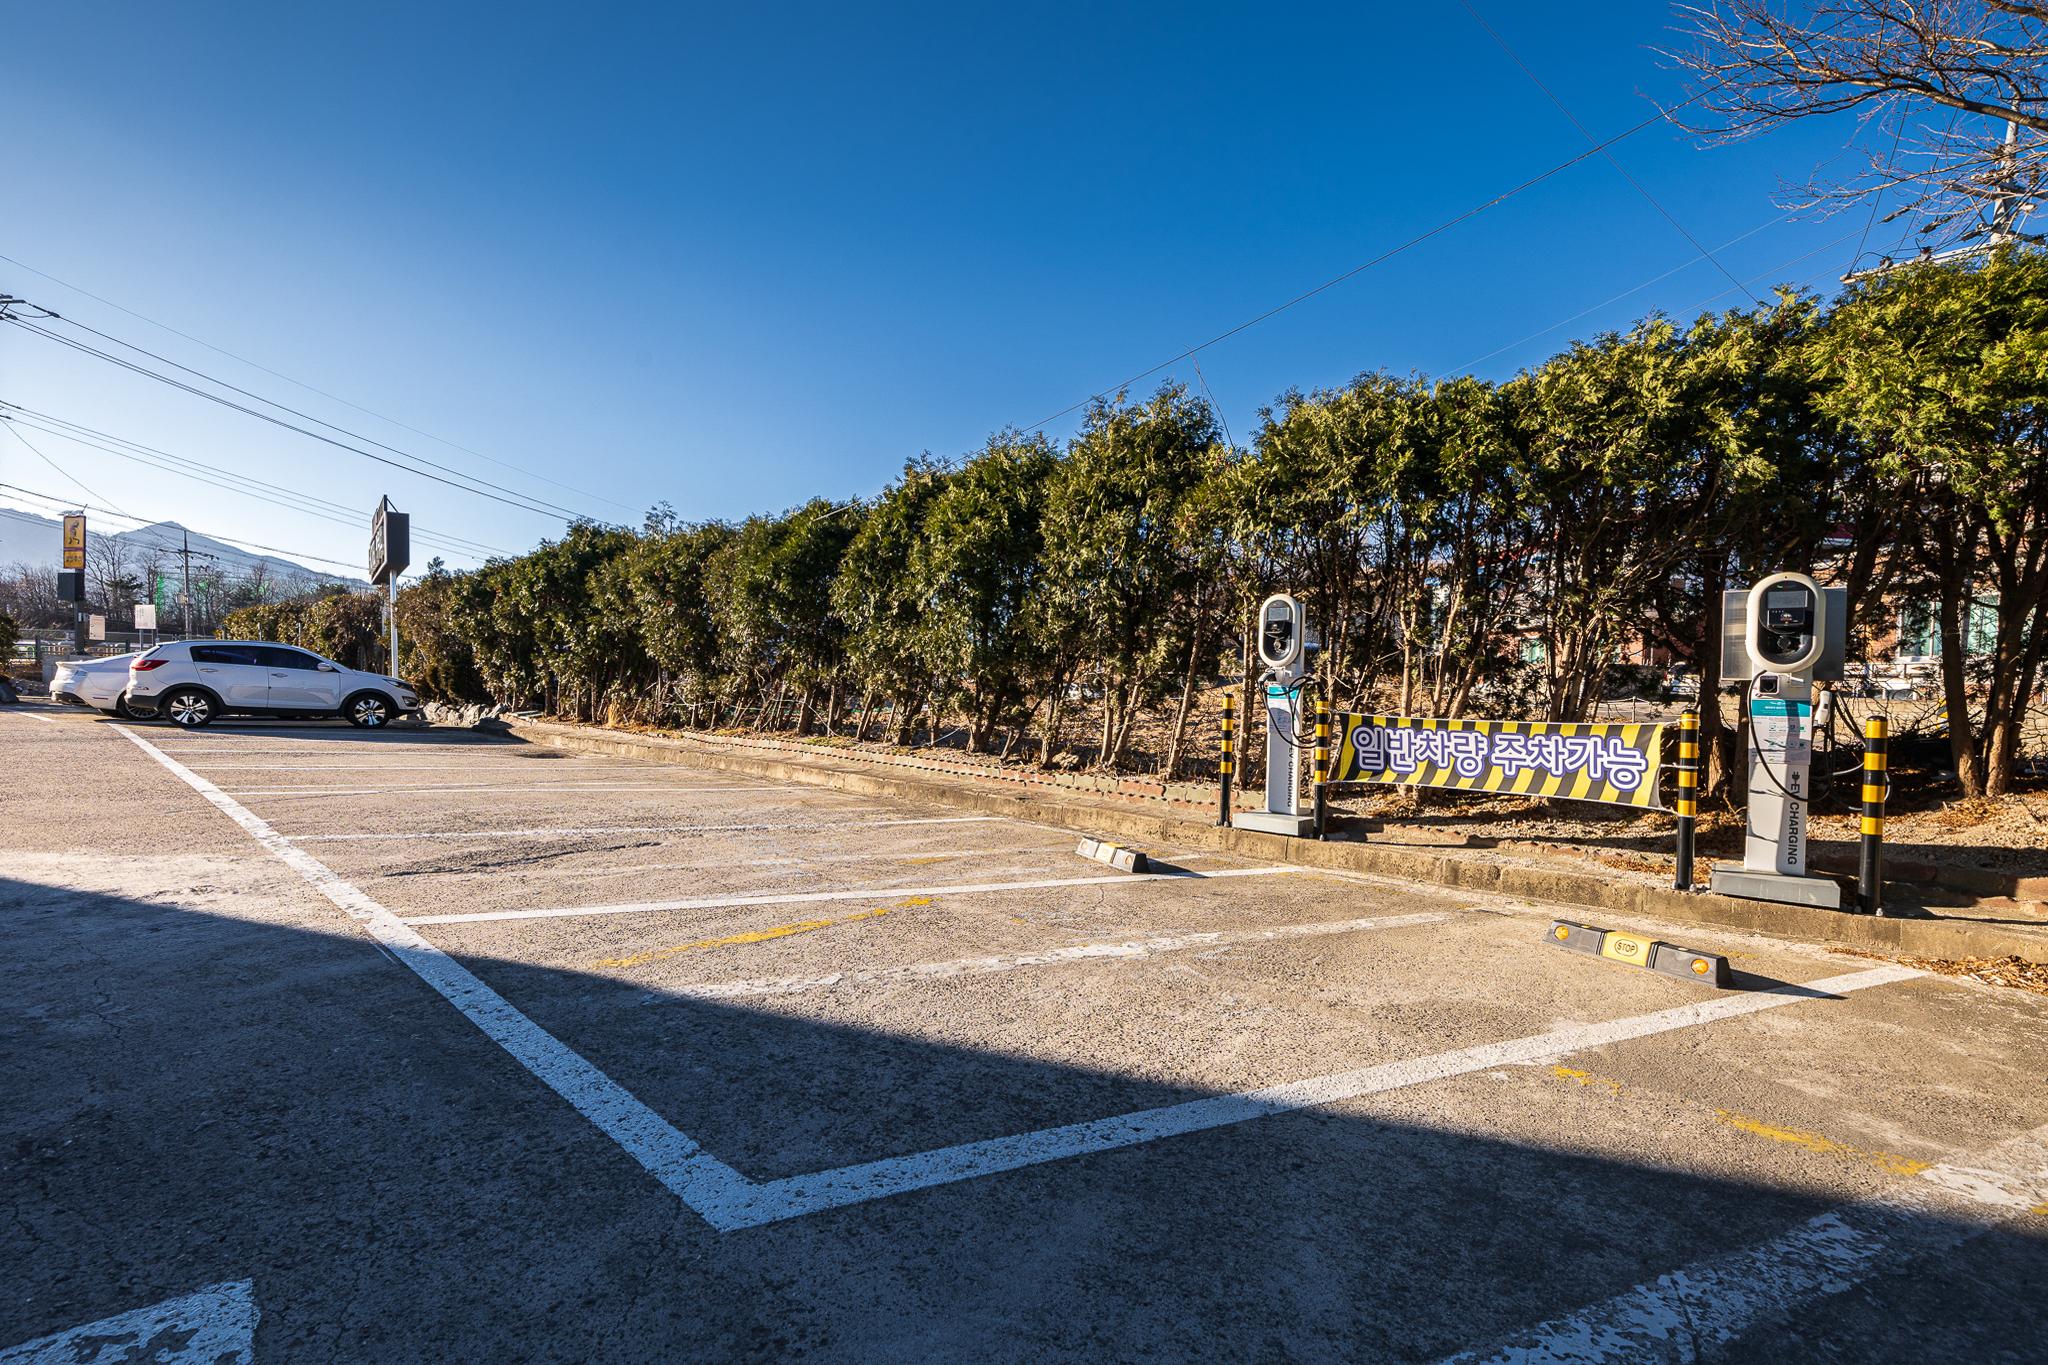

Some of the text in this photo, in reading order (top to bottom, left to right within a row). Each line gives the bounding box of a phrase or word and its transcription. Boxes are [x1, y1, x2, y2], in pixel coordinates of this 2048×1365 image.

[1351, 726, 1648, 792] 일반차량 주차가능
[1787, 802, 1800, 865] CHARGING
[1616, 942, 1635, 952] STOP
